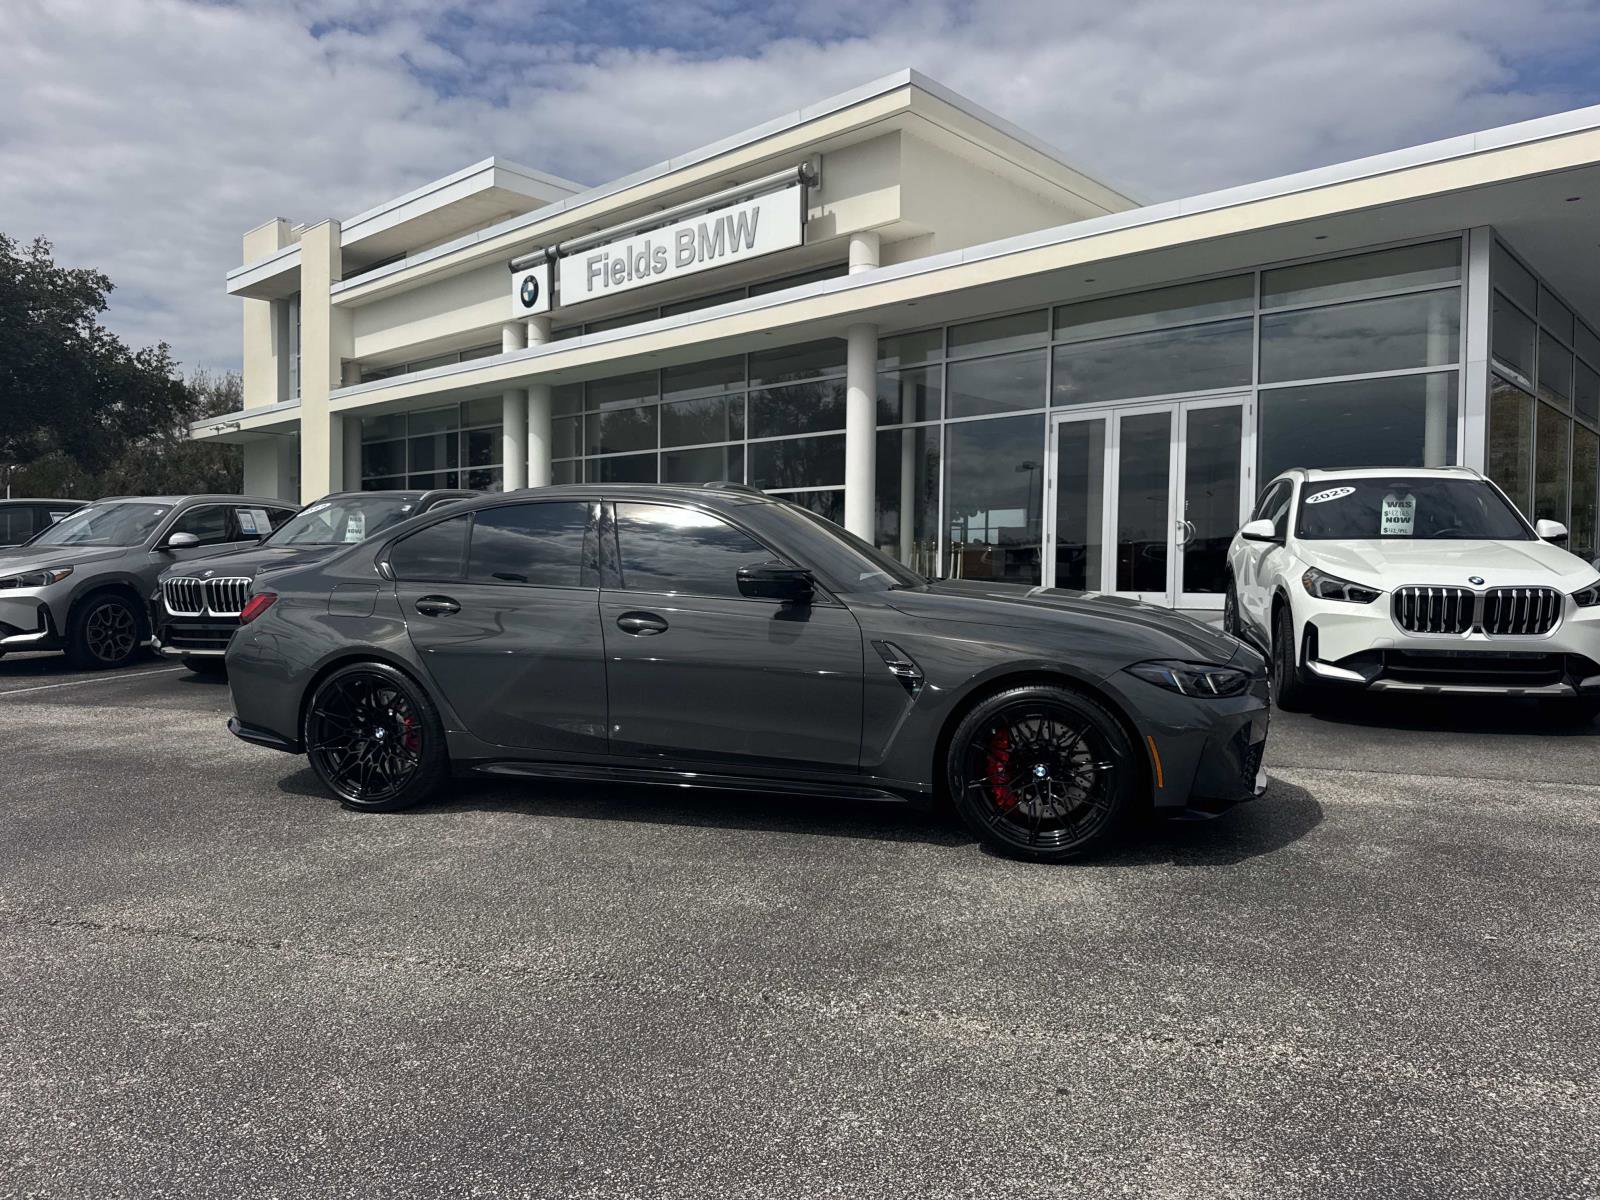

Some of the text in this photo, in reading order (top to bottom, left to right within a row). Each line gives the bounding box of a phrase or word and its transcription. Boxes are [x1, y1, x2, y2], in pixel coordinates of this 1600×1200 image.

[587, 207, 760, 292] Fields BMW
[1310, 487, 1350, 502] 2025
